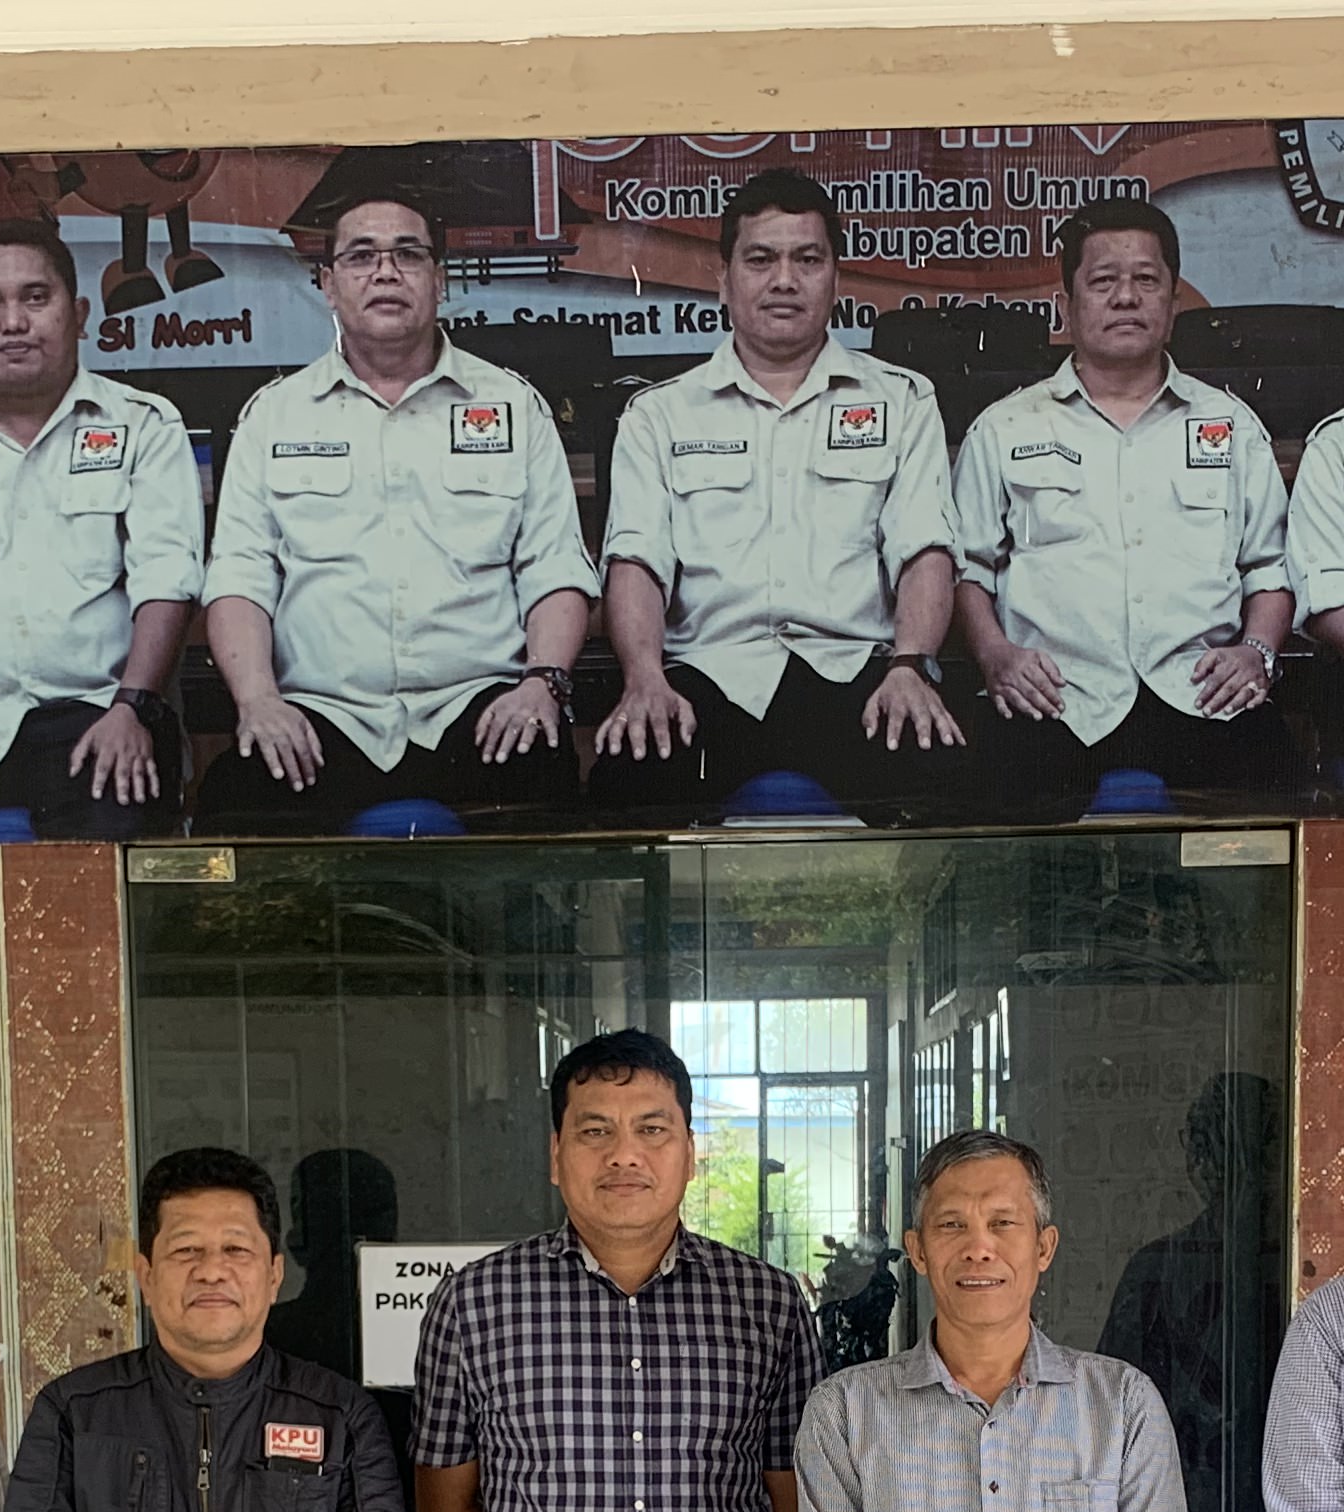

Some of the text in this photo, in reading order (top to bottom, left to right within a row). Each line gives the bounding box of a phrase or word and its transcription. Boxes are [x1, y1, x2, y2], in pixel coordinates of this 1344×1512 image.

[606, 168, 1150, 221] Komis milihan Umum
[839, 217, 1030, 268] bupaten
[97, 308, 252, 352] Si Morri
[395, 1261, 455, 1278] ZONA
[375, 1292, 435, 1310] PAK
[271, 1428, 317, 1445] KPU
